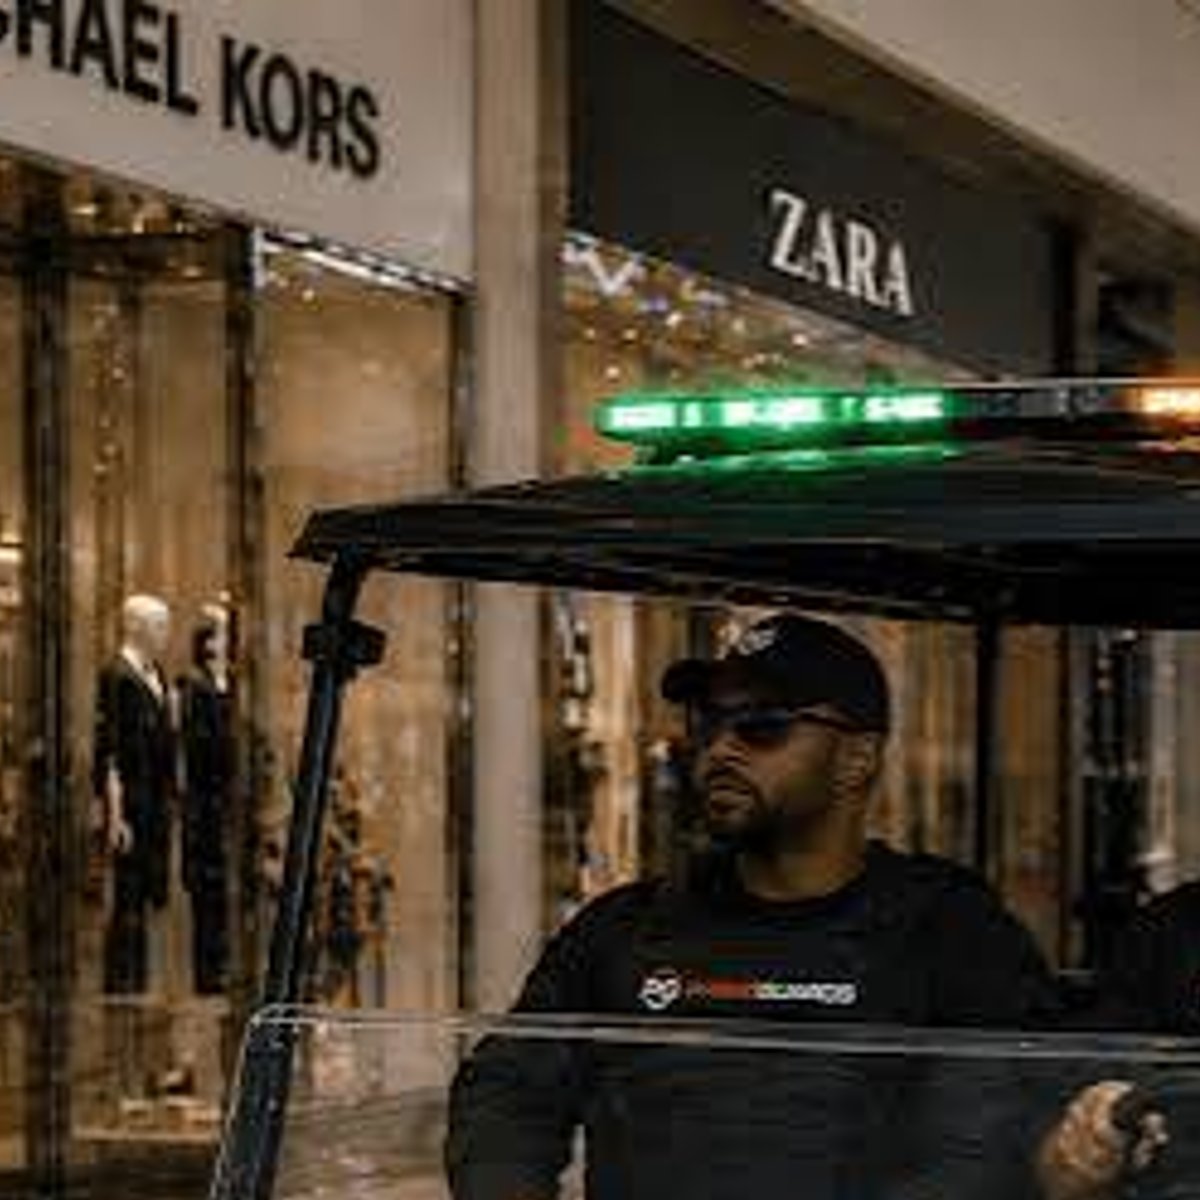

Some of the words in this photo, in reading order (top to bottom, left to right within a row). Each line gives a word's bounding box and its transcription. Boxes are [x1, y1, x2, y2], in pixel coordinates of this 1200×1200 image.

[0, 0, 198, 116] HAEL
[221, 35, 380, 179] KORS
[771, 189, 912, 316] ZARA
